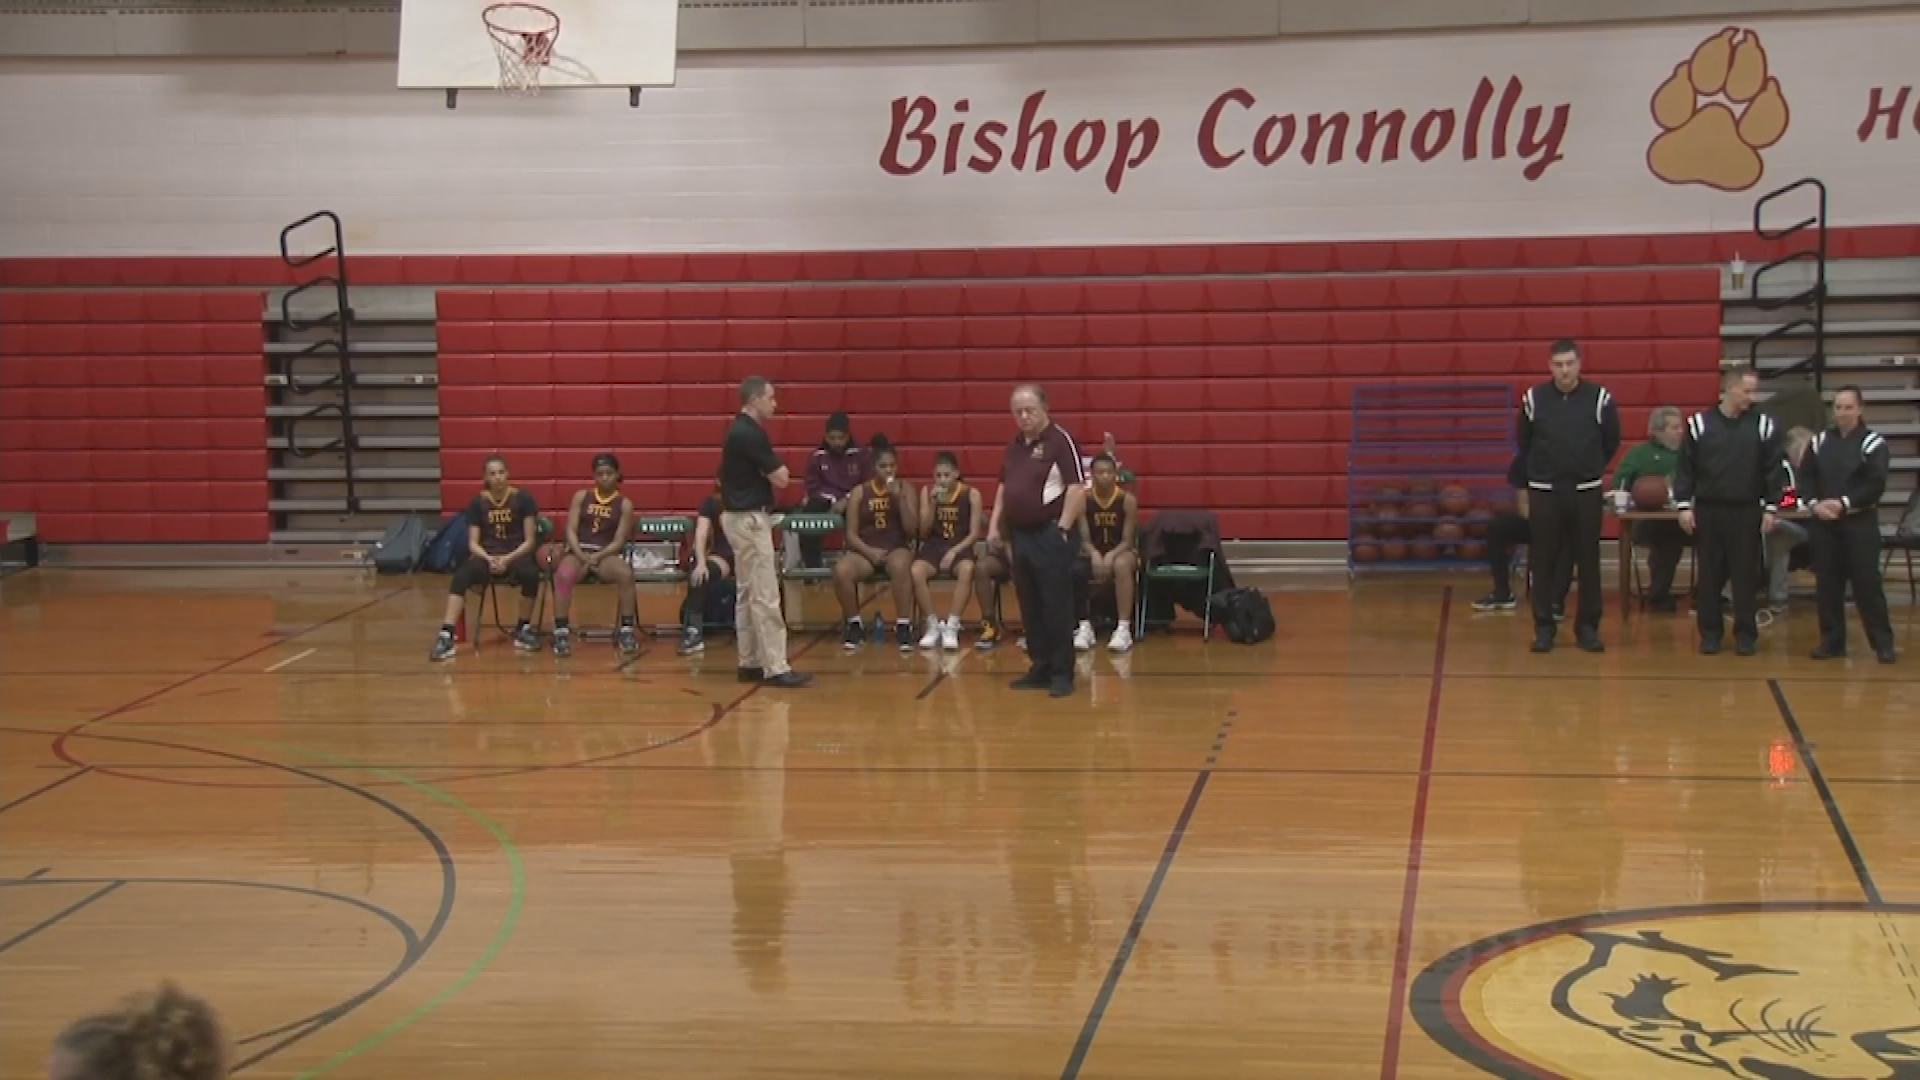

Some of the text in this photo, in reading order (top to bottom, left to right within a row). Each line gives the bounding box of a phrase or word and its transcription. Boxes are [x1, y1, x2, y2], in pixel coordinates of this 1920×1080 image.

[1856, 85, 1920, 142] H
[879, 74, 1571, 194] Bishop Connolly
[488, 509, 512, 524] STCC
[587, 503, 613, 519] STCC
[641, 522, 684, 532] BRISTOL
[791, 520, 835, 529] BRISTOL
